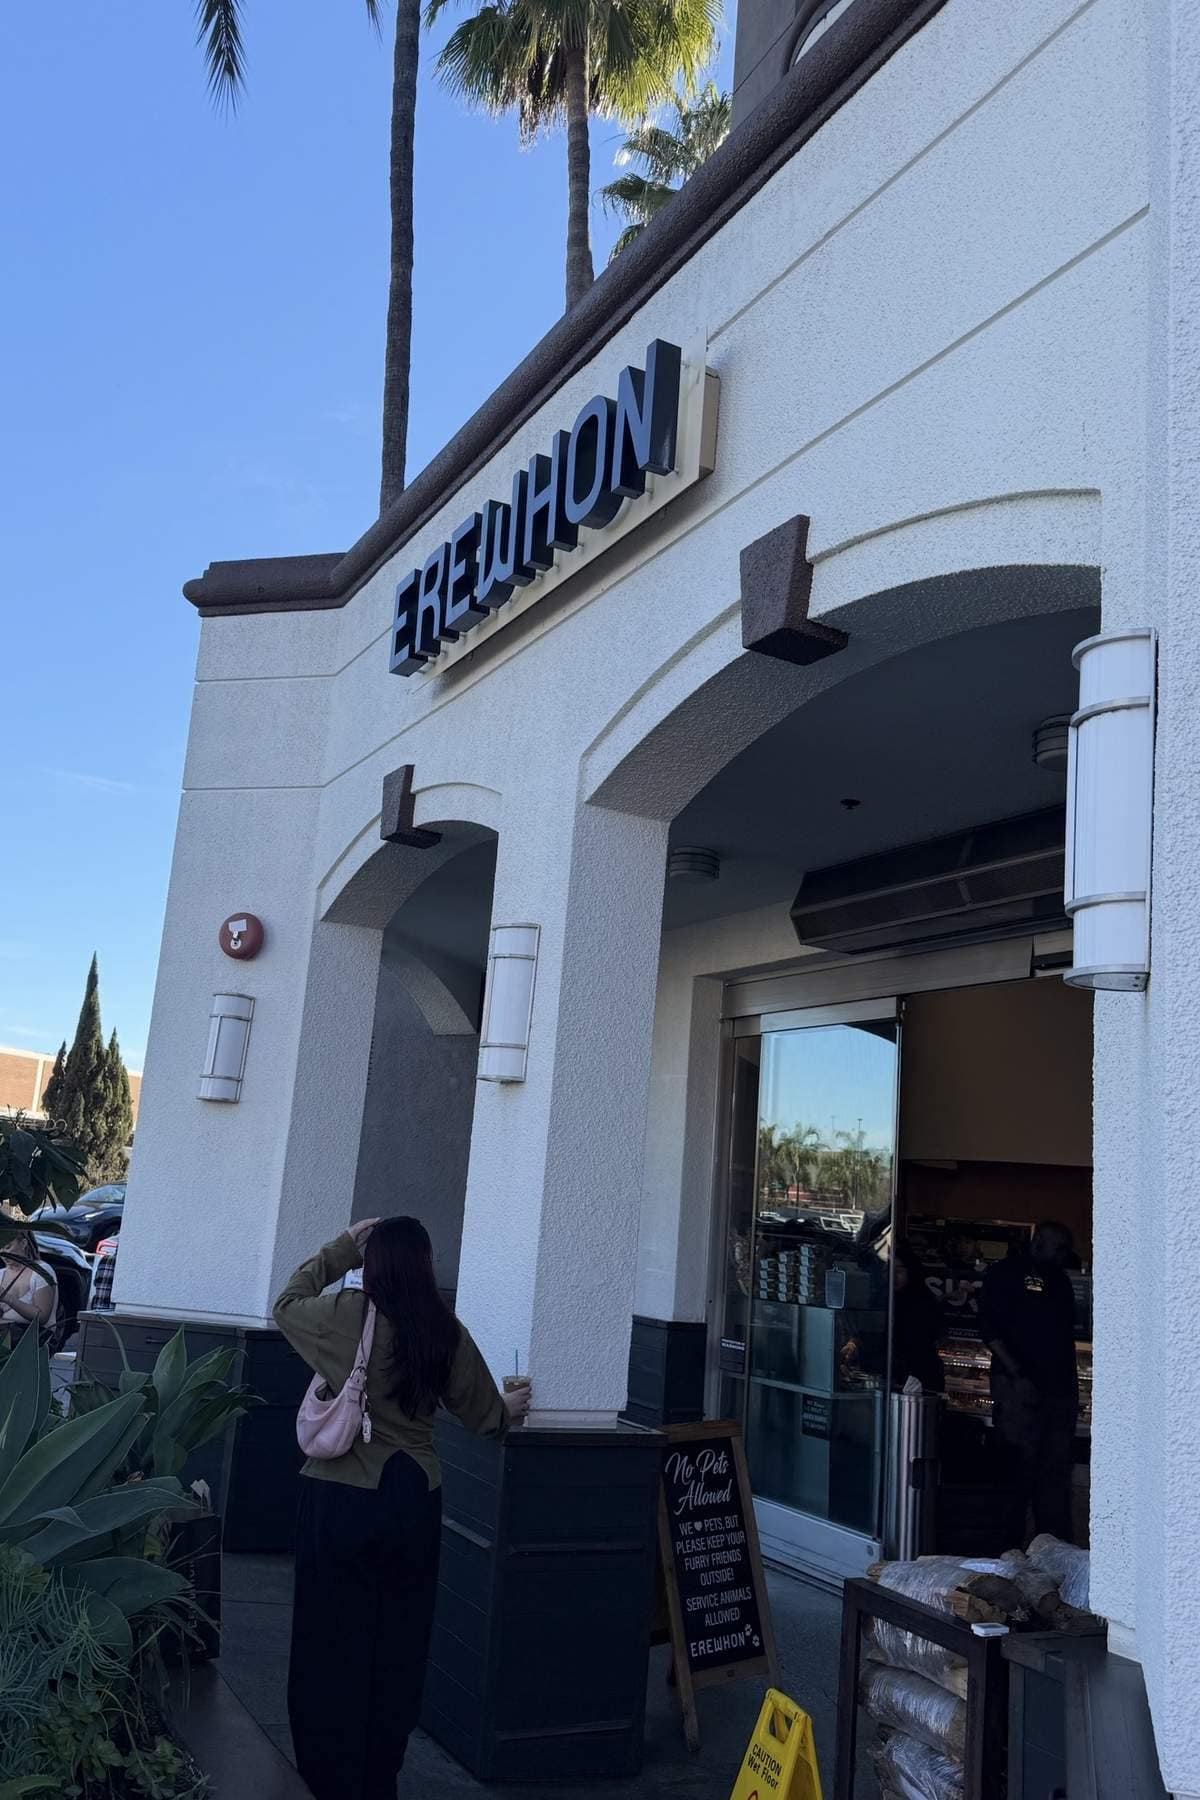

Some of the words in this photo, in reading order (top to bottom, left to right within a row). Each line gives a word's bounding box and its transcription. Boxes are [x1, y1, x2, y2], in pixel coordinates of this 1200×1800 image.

[389, 338, 682, 677] EREWHON
[665, 1452, 694, 1486] No
[696, 1448, 730, 1482] Pets
[673, 1478, 733, 1516] Allowed
[679, 1521, 693, 1537] WE
[704, 1517, 725, 1532] PETS,
[725, 1514, 738, 1529] BUT
[676, 1537, 706, 1555] PLEASE
[706, 1534, 725, 1549] KEEP
[726, 1530, 746, 1545] YOUR
[684, 1554, 710, 1571] FURRY
[711, 1548, 742, 1566] FRIENDS
[700, 1567, 734, 1586] OUTSIDE!
[686, 1593, 719, 1612] SERVICE
[720, 1586, 752, 1605] ANIMALS
[705, 1607, 740, 1628] ALLOWED
[690, 1632, 745, 1658] EREWHON
[748, 1753, 760, 1774] Wet
[761, 1767, 778, 1790] Floor
[752, 1743, 782, 1777] CAUTION
